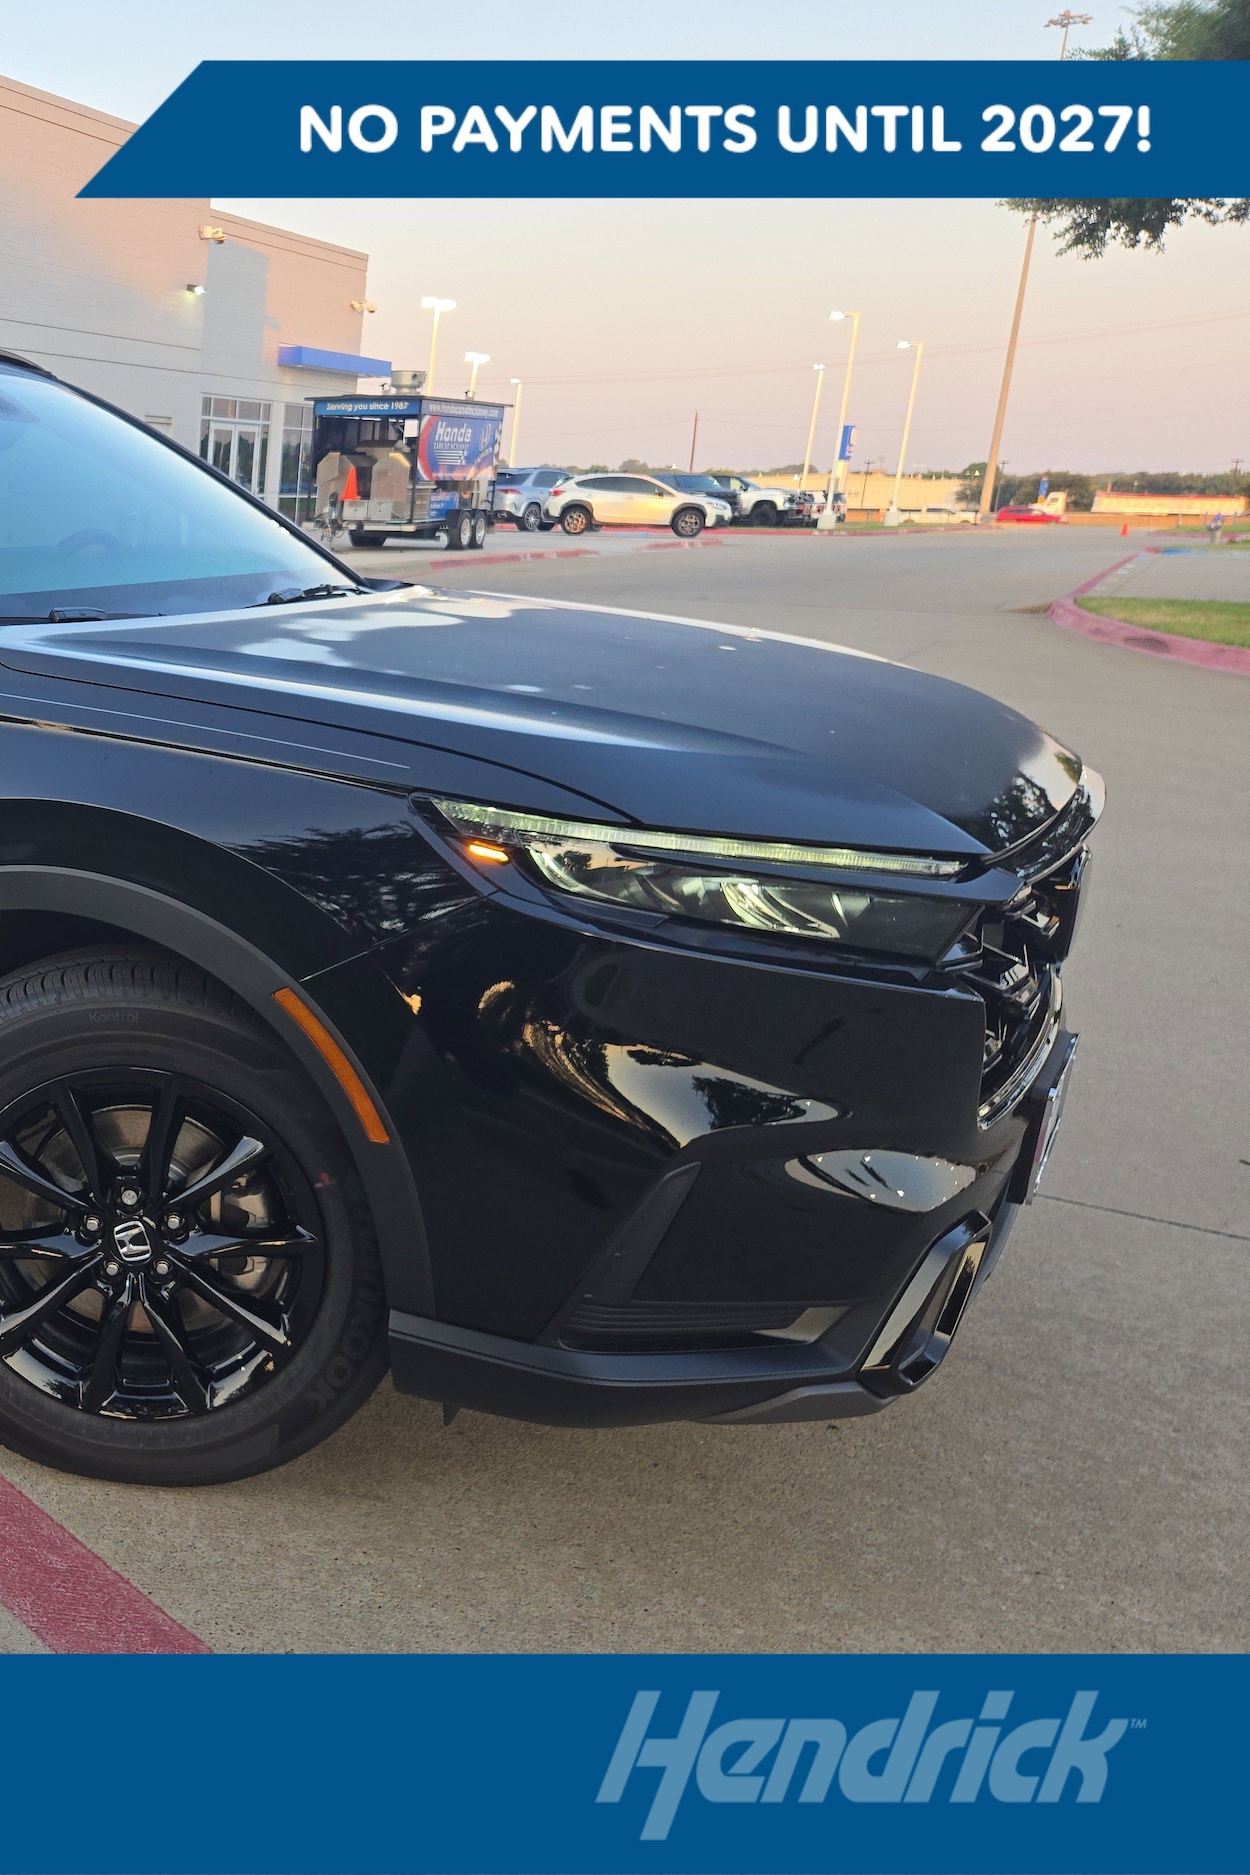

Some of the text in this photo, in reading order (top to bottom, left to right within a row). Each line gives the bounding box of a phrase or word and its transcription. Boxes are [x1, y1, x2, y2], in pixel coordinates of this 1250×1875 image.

[326, 401, 410, 412] Serving you since 1987
[435, 420, 472, 443] Honda
[88, 1011, 140, 1023] Kontrol
